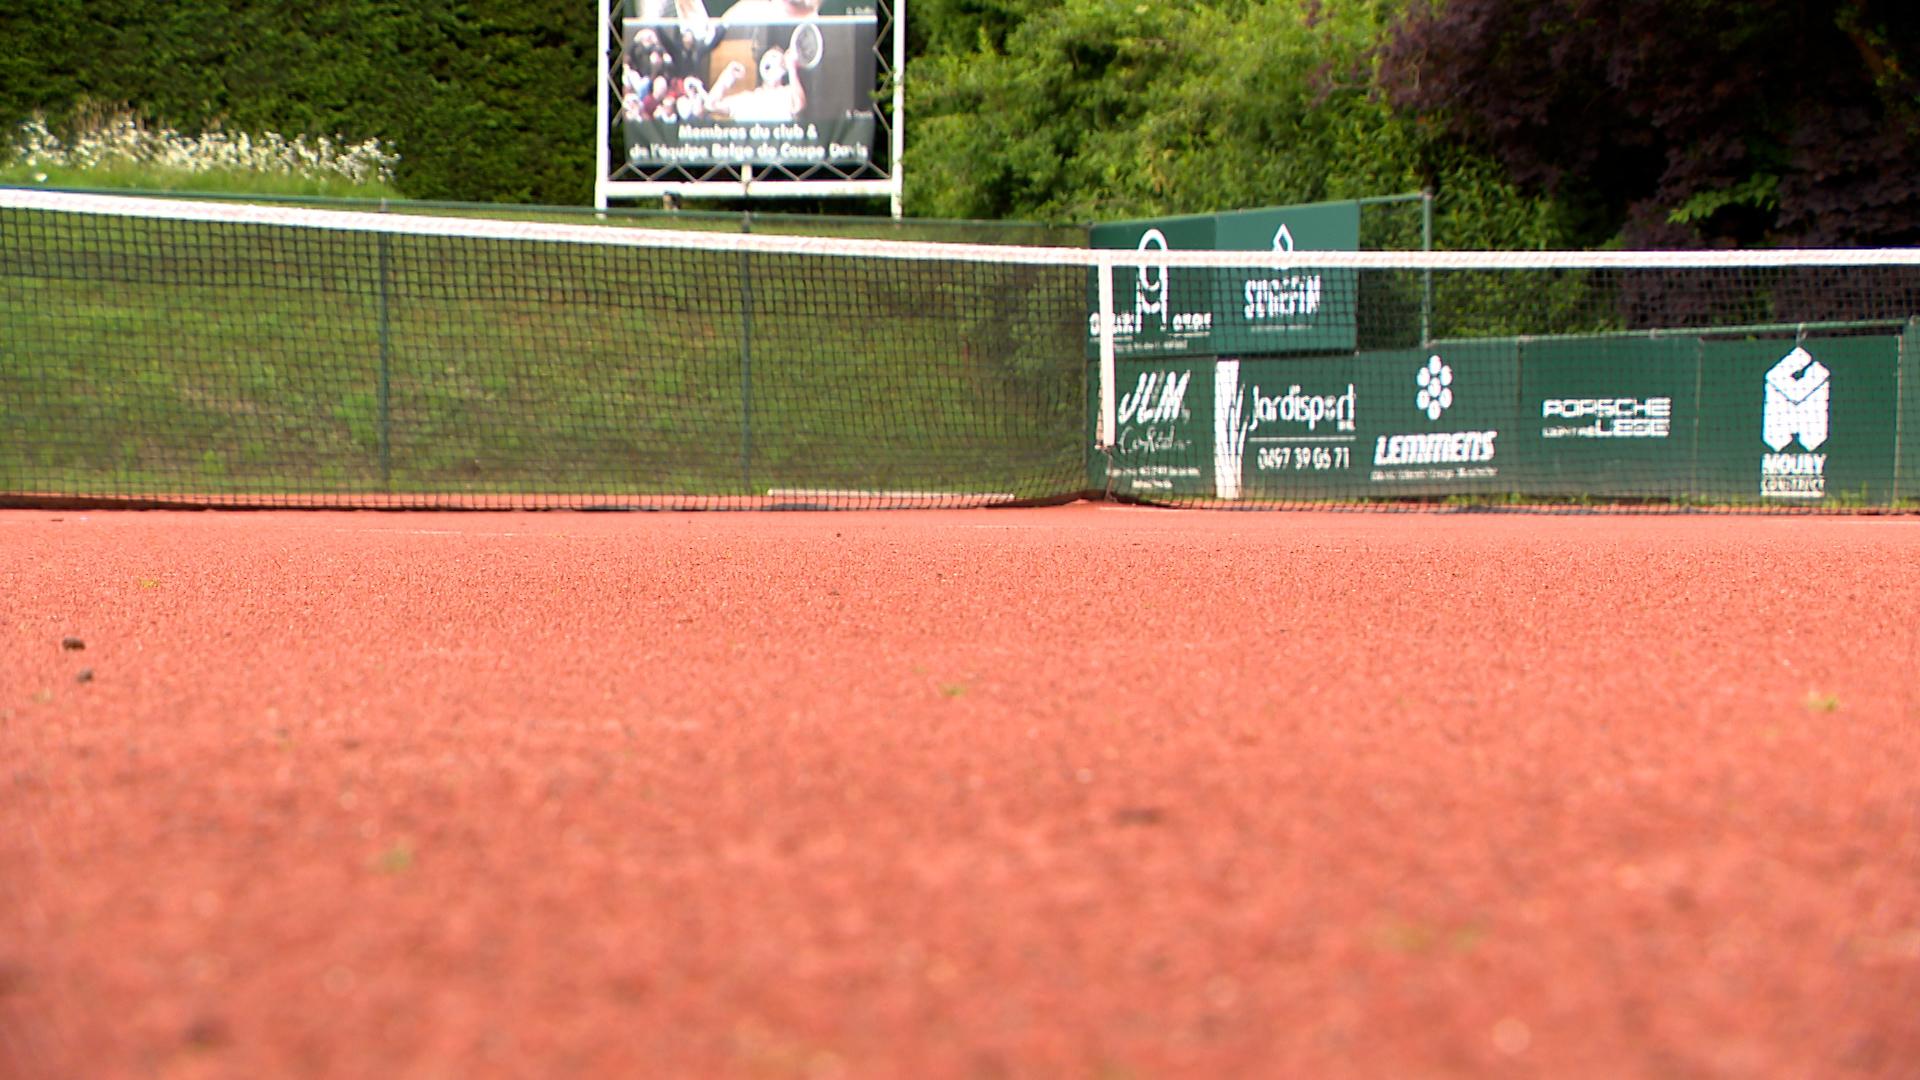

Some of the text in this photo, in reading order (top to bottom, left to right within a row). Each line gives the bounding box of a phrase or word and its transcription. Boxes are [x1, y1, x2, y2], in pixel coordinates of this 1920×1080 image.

[749, 123, 771, 140] du
[772, 123, 804, 140] club
[629, 143, 648, 160] de
[756, 142, 777, 160] de
[780, 142, 825, 161] Coupe
[1541, 397, 1671, 418] PORSCHE
[1373, 431, 1498, 466] LEMMENS
[1761, 453, 1828, 475] MOURY
